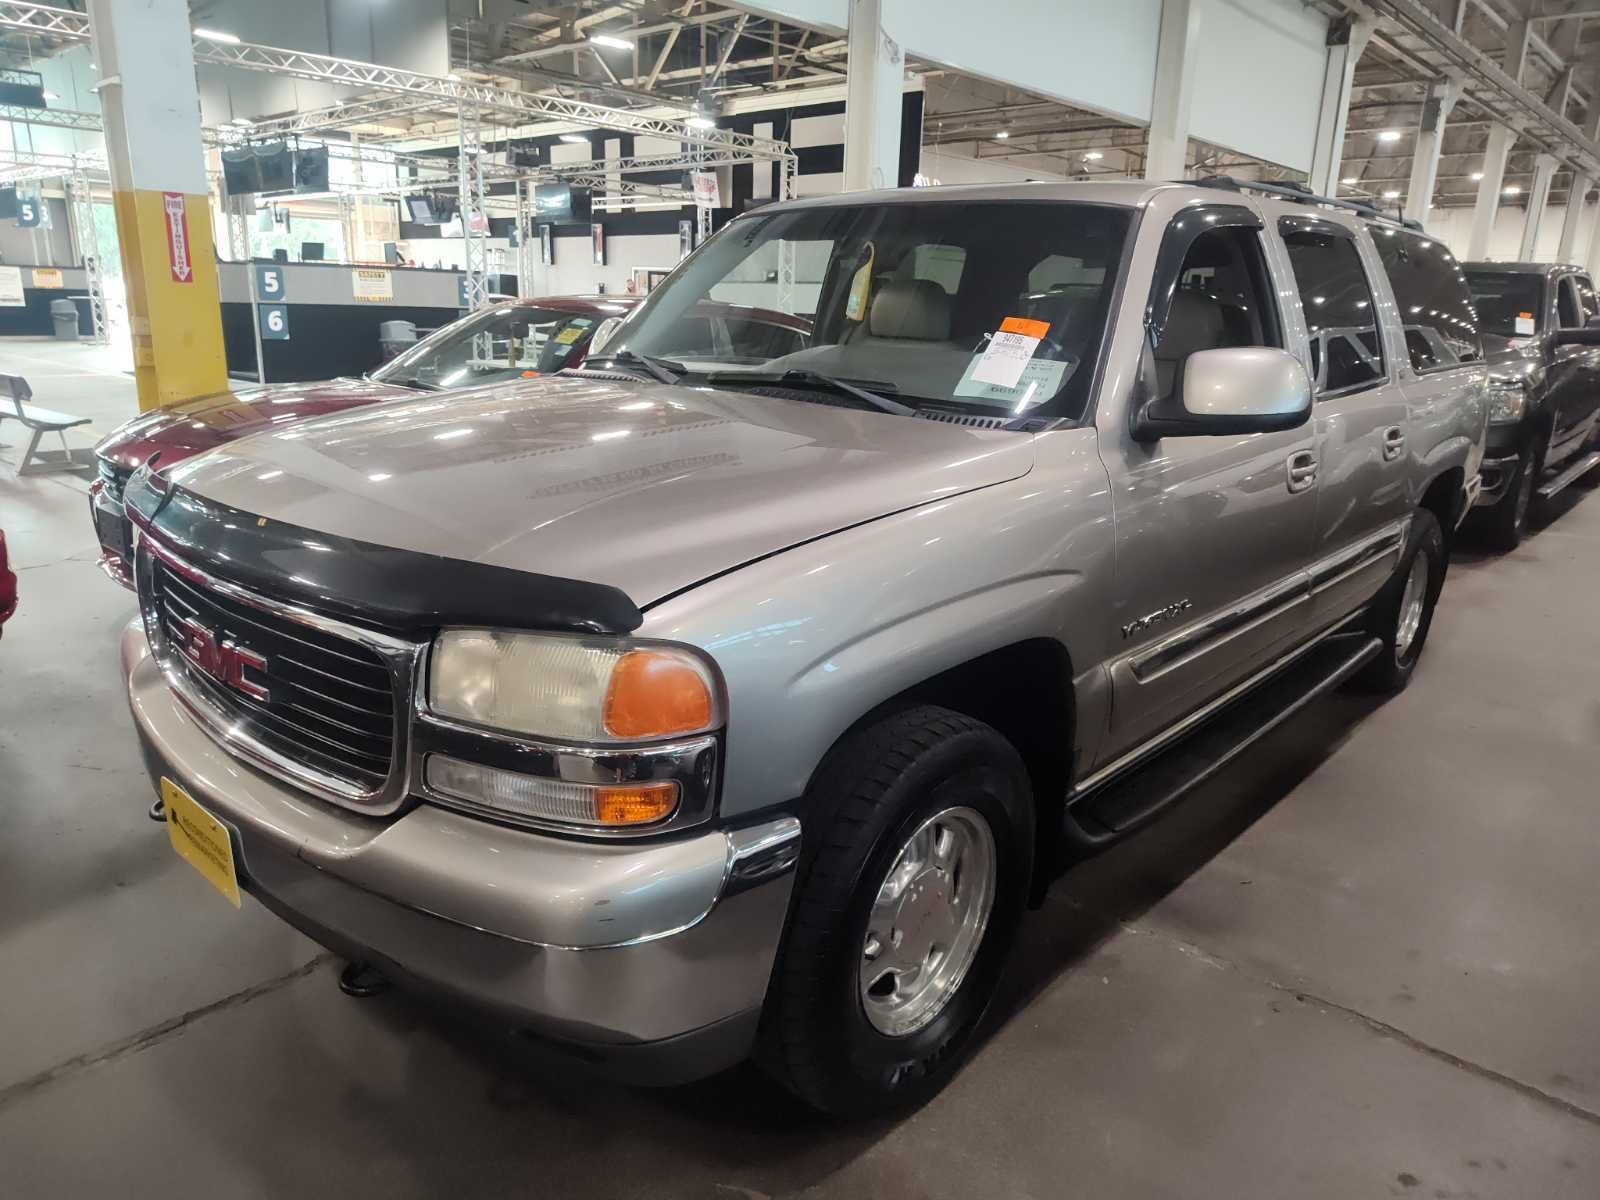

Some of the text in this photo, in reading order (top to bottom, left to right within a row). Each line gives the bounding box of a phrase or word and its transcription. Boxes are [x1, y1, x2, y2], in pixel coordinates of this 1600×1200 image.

[22, 204, 34, 221] 5
[264, 271, 280, 293] 5
[267, 310, 283, 332] 6
[180, 617, 271, 703] GMC
